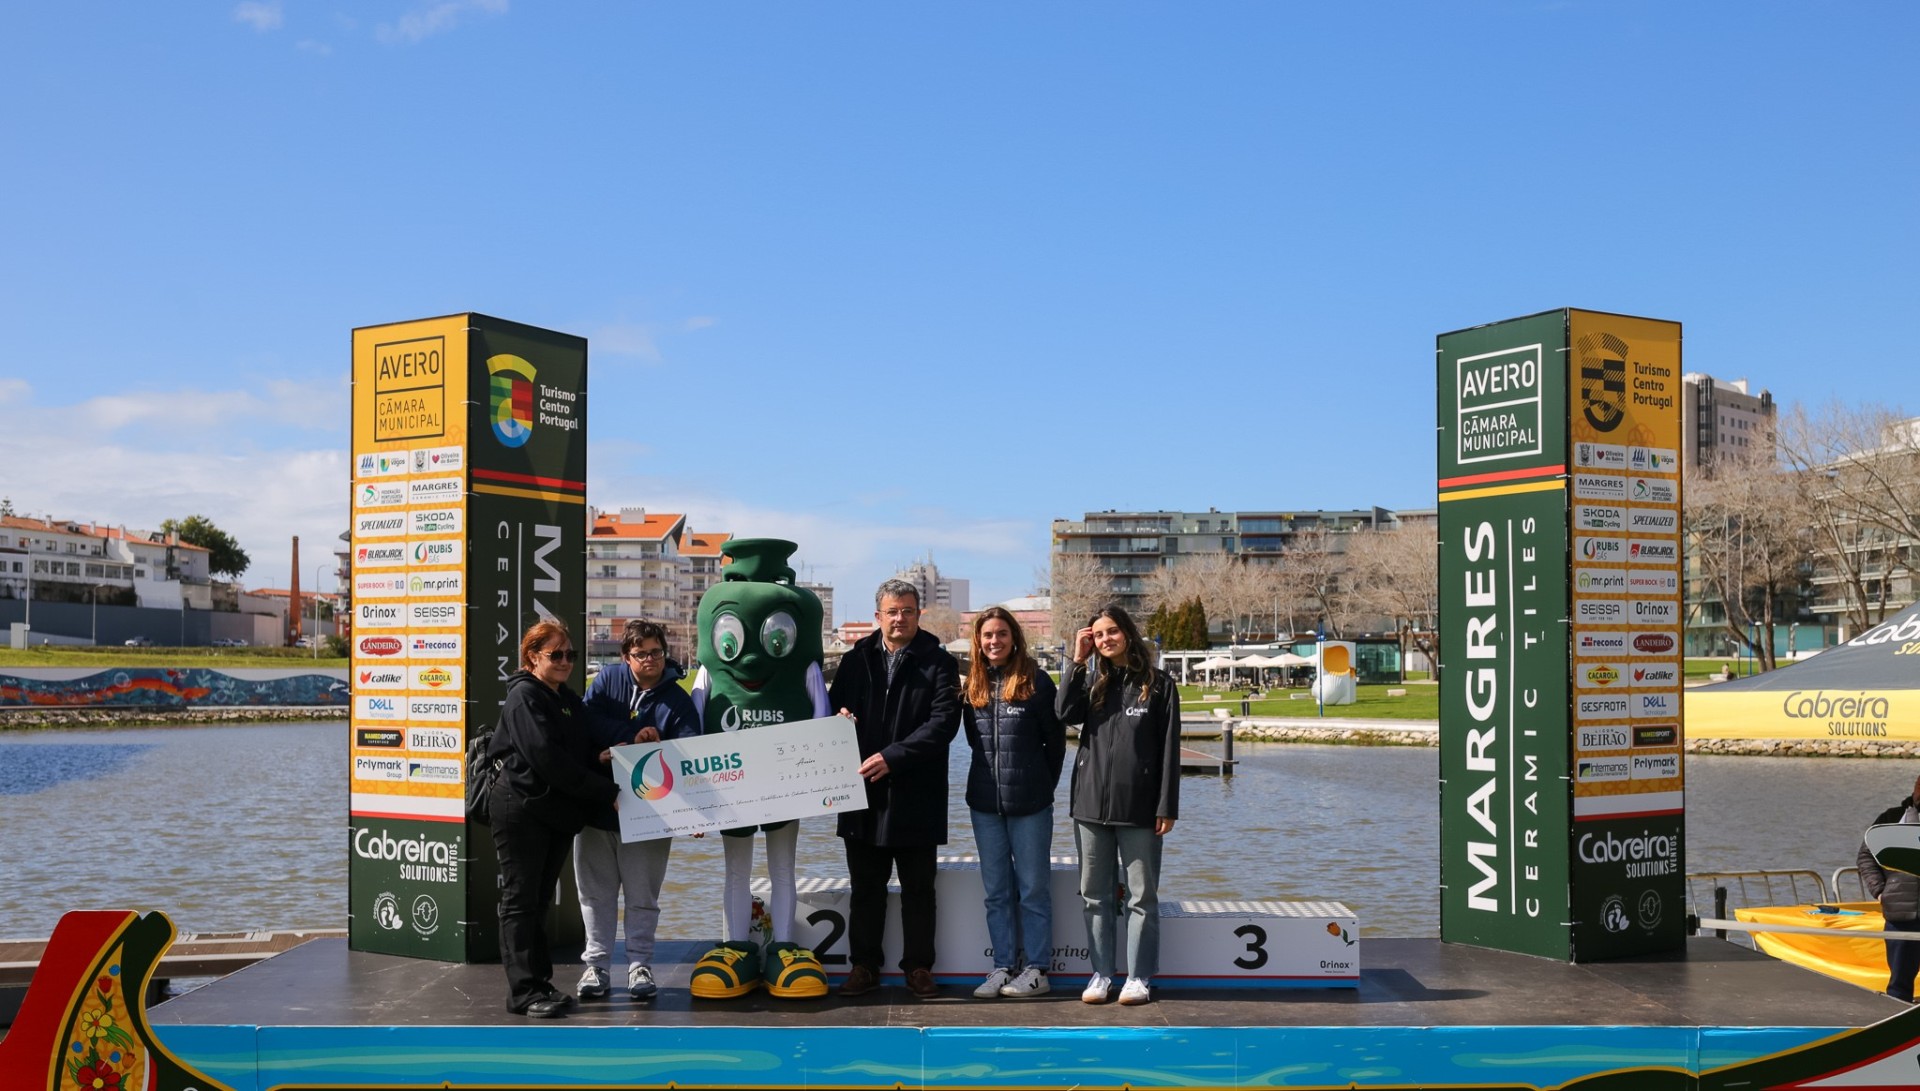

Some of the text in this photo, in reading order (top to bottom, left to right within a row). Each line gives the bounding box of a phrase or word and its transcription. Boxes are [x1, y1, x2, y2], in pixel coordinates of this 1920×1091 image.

[379, 350, 440, 380] AVEIRO
[1633, 362, 1670, 378] Turismo
[1463, 360, 1535, 398] AVEIRO
[1633, 378, 1664, 392] Centro
[540, 384, 576, 402] Turismo
[540, 399, 570, 414] Centro
[1633, 392, 1673, 410] Portugal
[379, 412, 440, 432] MUNICIPAL
[540, 412, 578, 430] Portugal
[1463, 428, 1536, 452] MUNICIPAL
[412, 482, 458, 492] MARGRES
[1579, 479, 1623, 488] MARGRES
[360, 519, 403, 530] SPECIALIZED
[1604, 520, 1620, 528] Cycling
[1632, 516, 1674, 526] SPECIALIZED
[424, 578, 458, 592] mr.print
[1591, 576, 1624, 587] mr.print
[414, 607, 456, 617] SEISSA
[1581, 604, 1620, 614] SEISSA
[1848, 614, 1920, 646] Cab
[362, 642, 399, 650] LANDEIRO
[1894, 642, 1920, 655] SO
[371, 674, 401, 683] catlike
[1645, 671, 1673, 680] catlike
[369, 699, 394, 710] DELL
[412, 704, 458, 714] GESFROTA
[1582, 701, 1626, 712] GESFROTA
[1643, 696, 1667, 708] DELL
[1784, 691, 1889, 718] Cabreira
[1464, 521, 1498, 912] MARGRES
[1522, 516, 1539, 917] CERAMIC TILES
[1828, 722, 1887, 737] SOLUTIONS
[412, 734, 457, 748] BEIRÃO
[1583, 731, 1626, 746] BEIRÃO
[712, 770, 744, 783] CAUSA
[355, 828, 448, 864] Cabreira
[1579, 830, 1670, 863] Cabreira
[449, 844, 458, 882] EVENTOS
[1626, 860, 1669, 878] SOLUTIONS
[400, 864, 448, 883] SOLUTIONS
[806, 909, 847, 964] 2
[1232, 924, 1268, 969] 3
